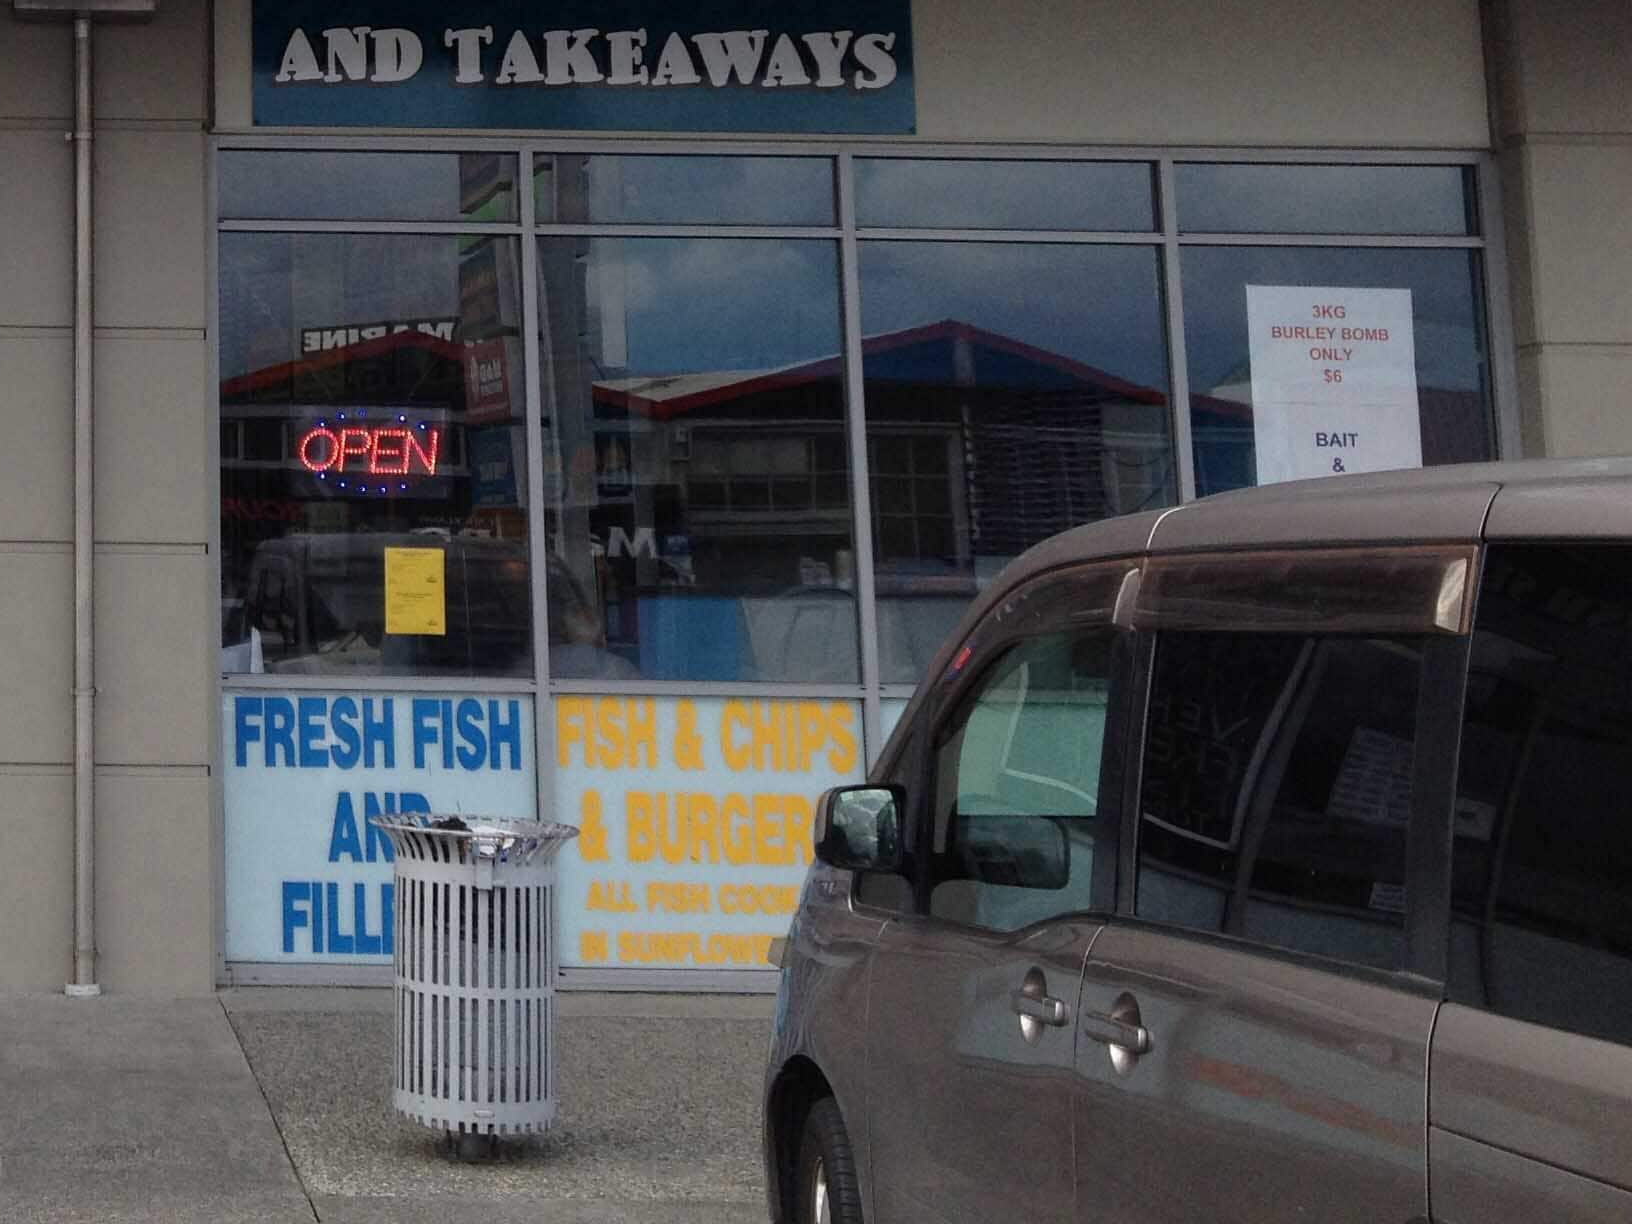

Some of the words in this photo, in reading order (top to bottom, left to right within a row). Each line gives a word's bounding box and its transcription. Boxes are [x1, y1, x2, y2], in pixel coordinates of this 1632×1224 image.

[274, 25, 425, 85] AND
[444, 24, 898, 90] TAKEAWAYS
[1311, 304, 1347, 320] 3KG
[1270, 325, 1336, 341] BURLEY
[1340, 327, 1390, 342] BOMB
[1308, 346, 1354, 362] ONLY
[1322, 368, 1343, 384] $6
[300, 427, 439, 475] OPEN
[1314, 431, 1360, 449] BAIT
[1331, 456, 1346, 474] &
[234, 695, 396, 770] FRESH
[412, 697, 522, 772] FISH
[556, 695, 657, 771] FISH
[673, 696, 706, 772] &
[719, 697, 858, 775] CHIPS
[578, 788, 610, 863] &
[625, 790, 818, 866] BURGER
[585, 879, 639, 913] ALL
[645, 880, 711, 915] FISH
[579, 929, 609, 962] IN
